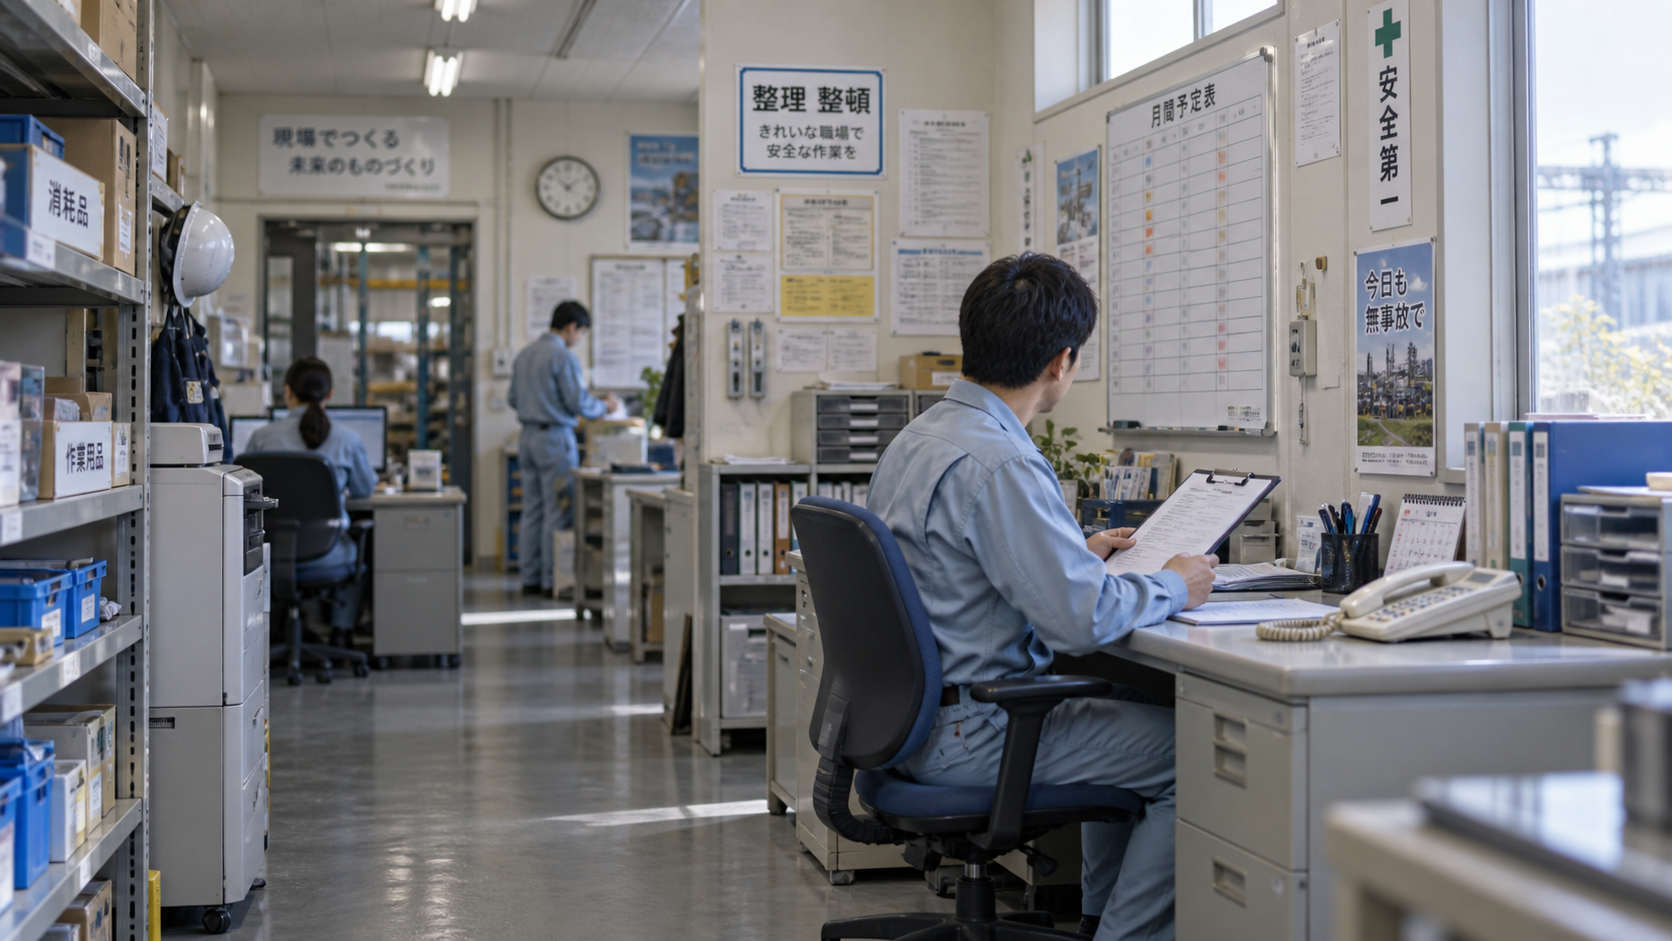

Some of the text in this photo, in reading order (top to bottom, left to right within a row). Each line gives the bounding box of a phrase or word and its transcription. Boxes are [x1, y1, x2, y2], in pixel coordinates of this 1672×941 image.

[752, 84, 871, 115] 整理 整頓
[1151, 83, 1216, 128] 月間予定表
[272, 126, 401, 149] 現場でつくる
[758, 124, 866, 141] きれいな職場で
[1379, 65, 1399, 206] 安全第一
[288, 155, 436, 177] 未来のものづくり
[766, 143, 857, 160] 安全な作業を
[48, 179, 89, 229] 消耗品
[1365, 268, 1407, 300] 今日も
[1365, 301, 1425, 334] 無事故で
[66, 442, 104, 475] 作業用品
